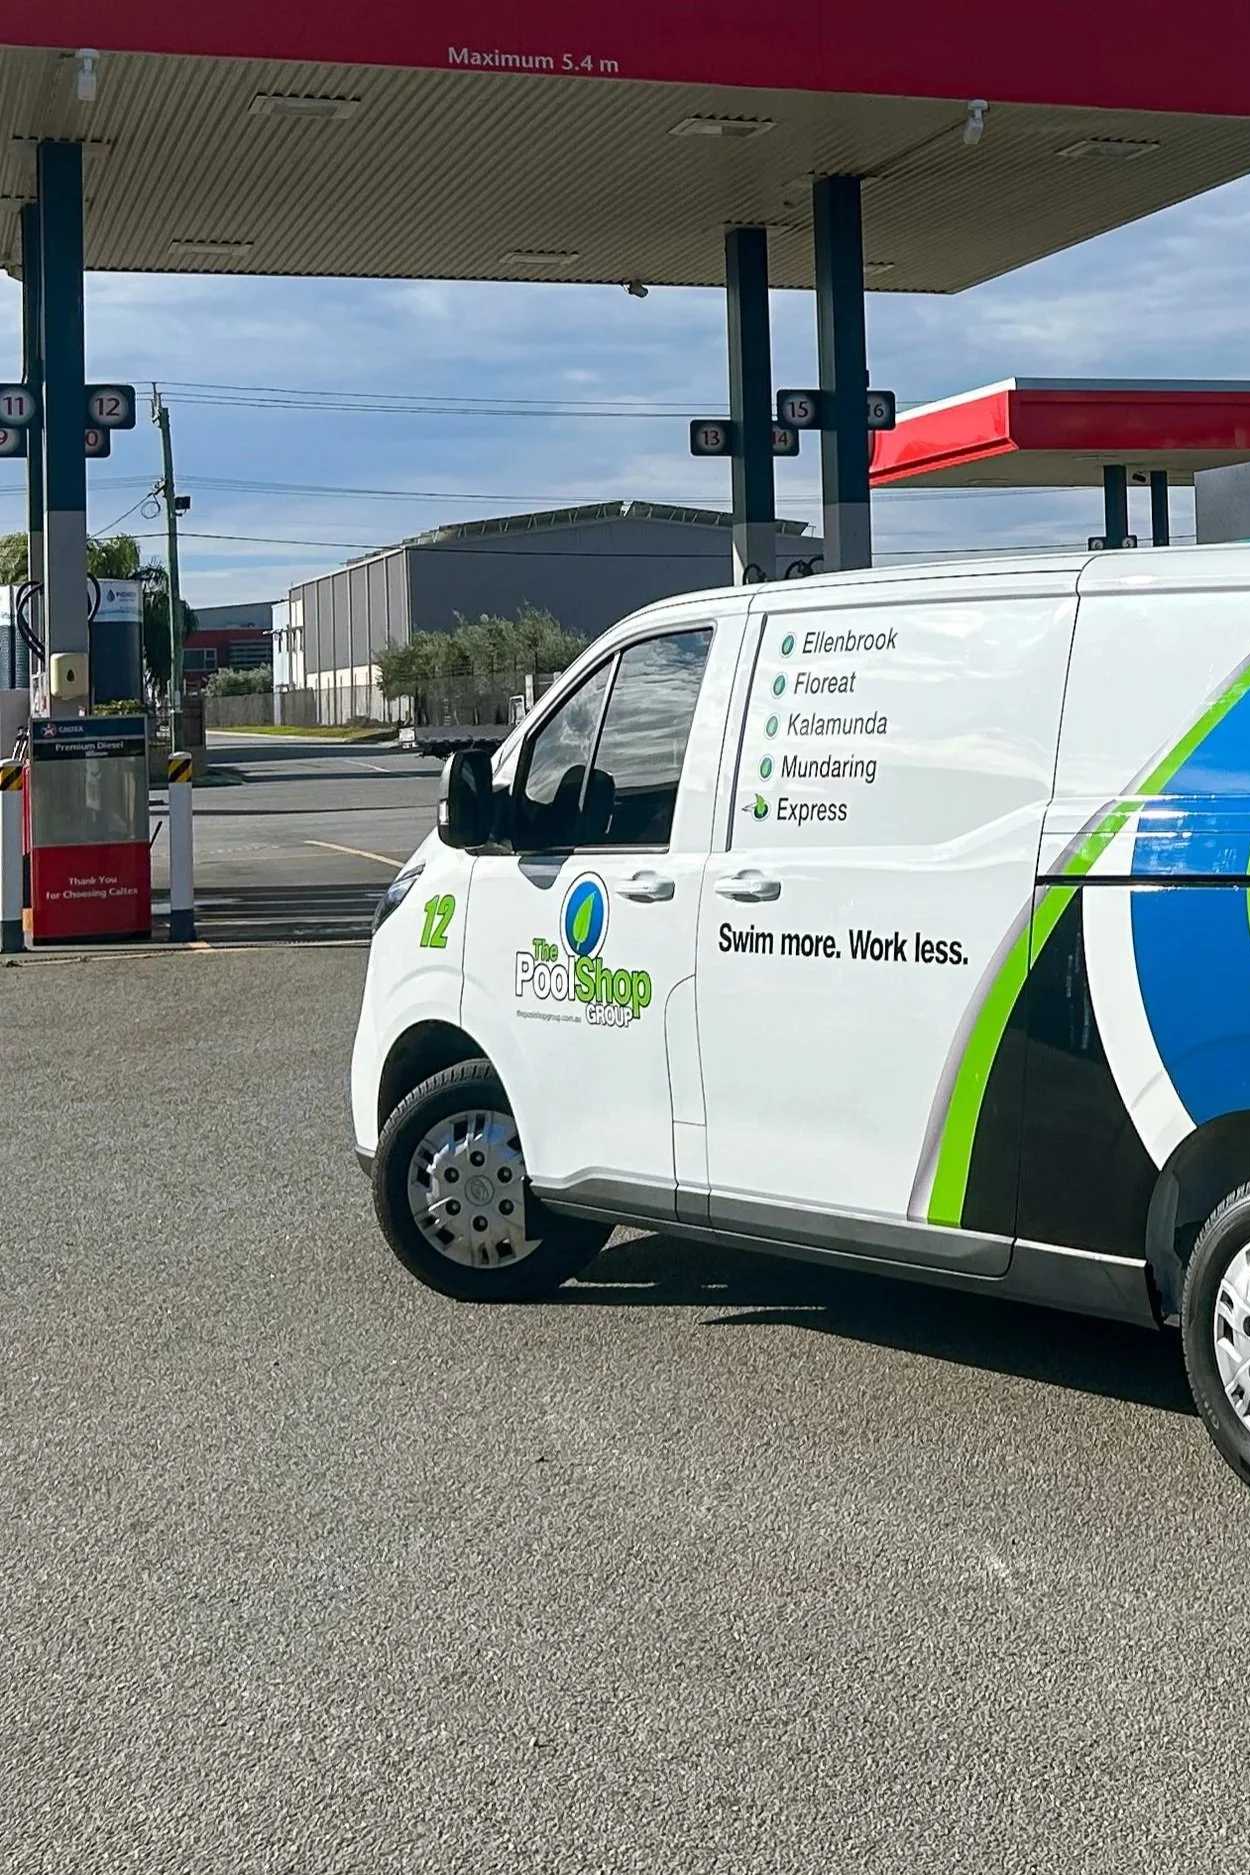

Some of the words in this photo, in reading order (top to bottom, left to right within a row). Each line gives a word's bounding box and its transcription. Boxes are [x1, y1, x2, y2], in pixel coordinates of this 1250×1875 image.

[448, 47, 554, 70] Maximum
[561, 54, 594, 72] 5.4
[600, 59, 619, 73] m
[3, 396, 25, 416] 11
[95, 397, 120, 417] 12
[789, 401, 809, 418] 15
[84, 430, 99, 447] 0
[701, 430, 721, 446] 13
[772, 431, 789, 446] 14
[801, 626, 899, 655] Ellenbrook
[793, 670, 857, 695] Floreat
[786, 710, 888, 737] Kalamunda
[55, 742, 96, 752] Premium
[97, 740, 124, 751] Diesel
[780, 754, 878, 785] Mundaring
[776, 796, 849, 827] Express
[68, 876, 97, 887] Thank
[98, 874, 119, 885] You
[45, 890, 61, 901] for
[63, 888, 107, 900] Choosing
[108, 886, 138, 897] Caltex
[420, 893, 457, 949] 12
[532, 937, 559, 963] The
[718, 922, 775, 955] Swim
[780, 931, 842, 959] more.
[848, 928, 908, 963] Work
[914, 931, 969, 965] less.
[585, 1003, 635, 1029] GROUP
